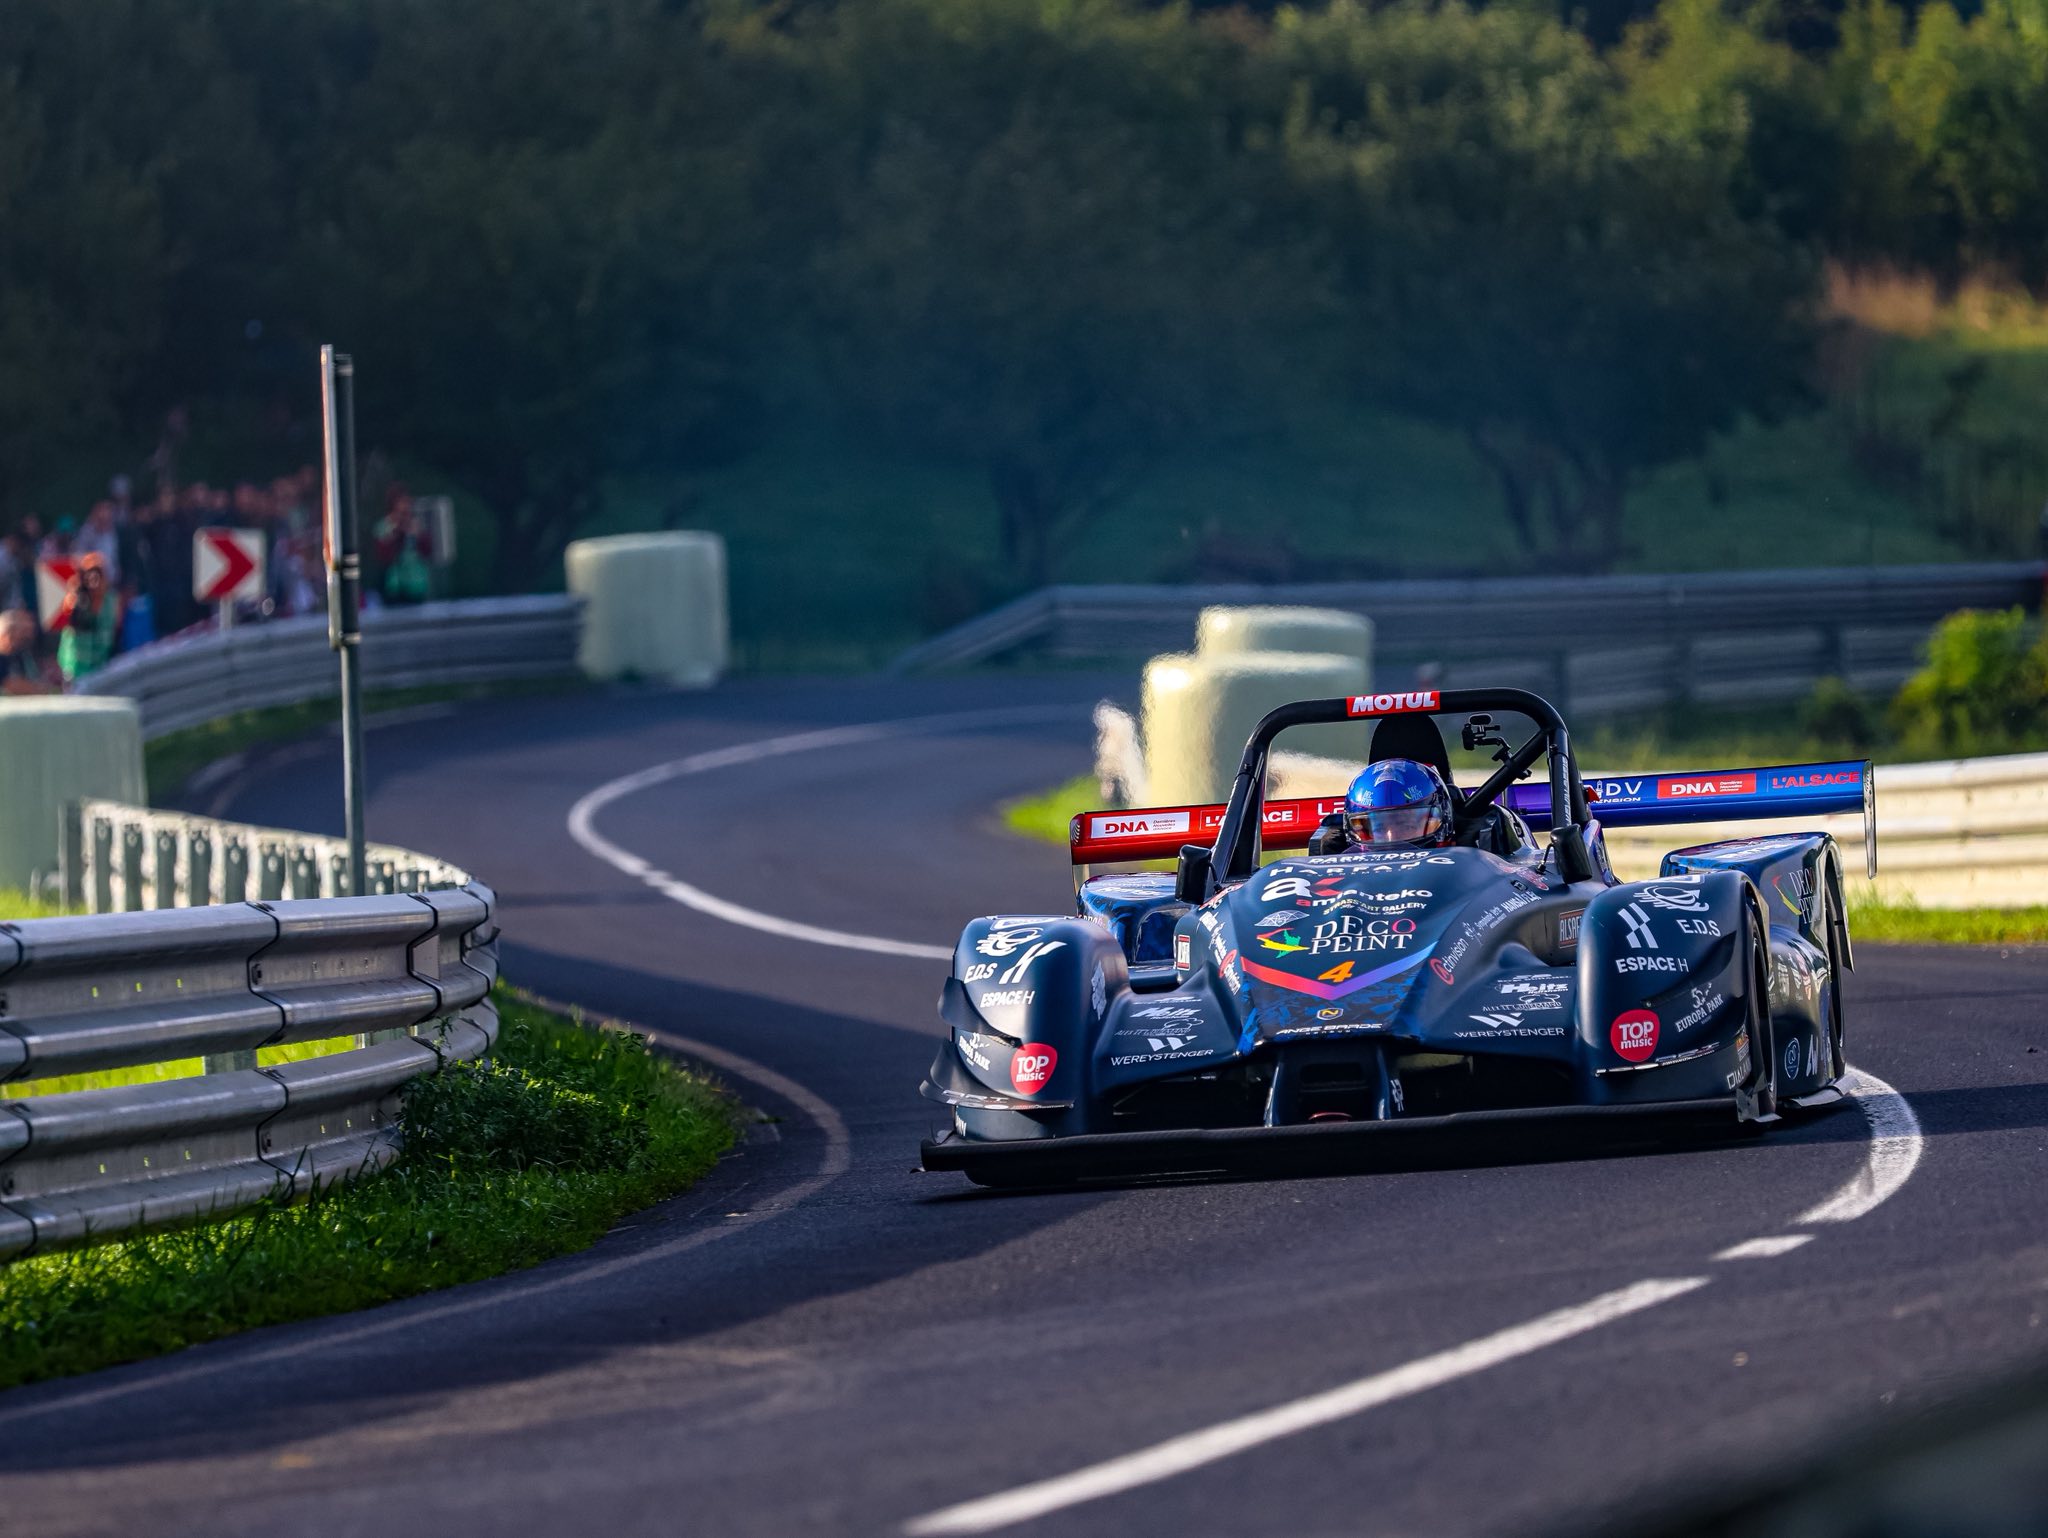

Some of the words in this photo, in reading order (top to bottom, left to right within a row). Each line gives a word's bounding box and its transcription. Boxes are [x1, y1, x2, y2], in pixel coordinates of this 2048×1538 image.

[1352, 691, 1435, 713] MOTUL
[1671, 782, 1717, 795] DNA
[1772, 772, 1860, 789] L'ALSACE
[1105, 821, 1149, 834] DNA
[1312, 915, 1417, 940] DECO
[1309, 934, 1413, 955] PEINT
[1318, 961, 1355, 983] 4
[1615, 956, 1677, 973] ESPACE
[1679, 958, 1690, 973] H
[980, 991, 1023, 1008] ESPACE
[1023, 990, 1036, 1005] H
[1675, 1009, 1708, 1032] EUROPA
[1706, 993, 1724, 1015] PARK
[1453, 1027, 1565, 1038] WEREYSTENGER
[1618, 1021, 1655, 1041] TOP
[1620, 1037, 1653, 1049] music
[1017, 1056, 1050, 1074] TOP
[1110, 1049, 1214, 1066] WEREYSTENGER
[1016, 1072, 1046, 1082] music
